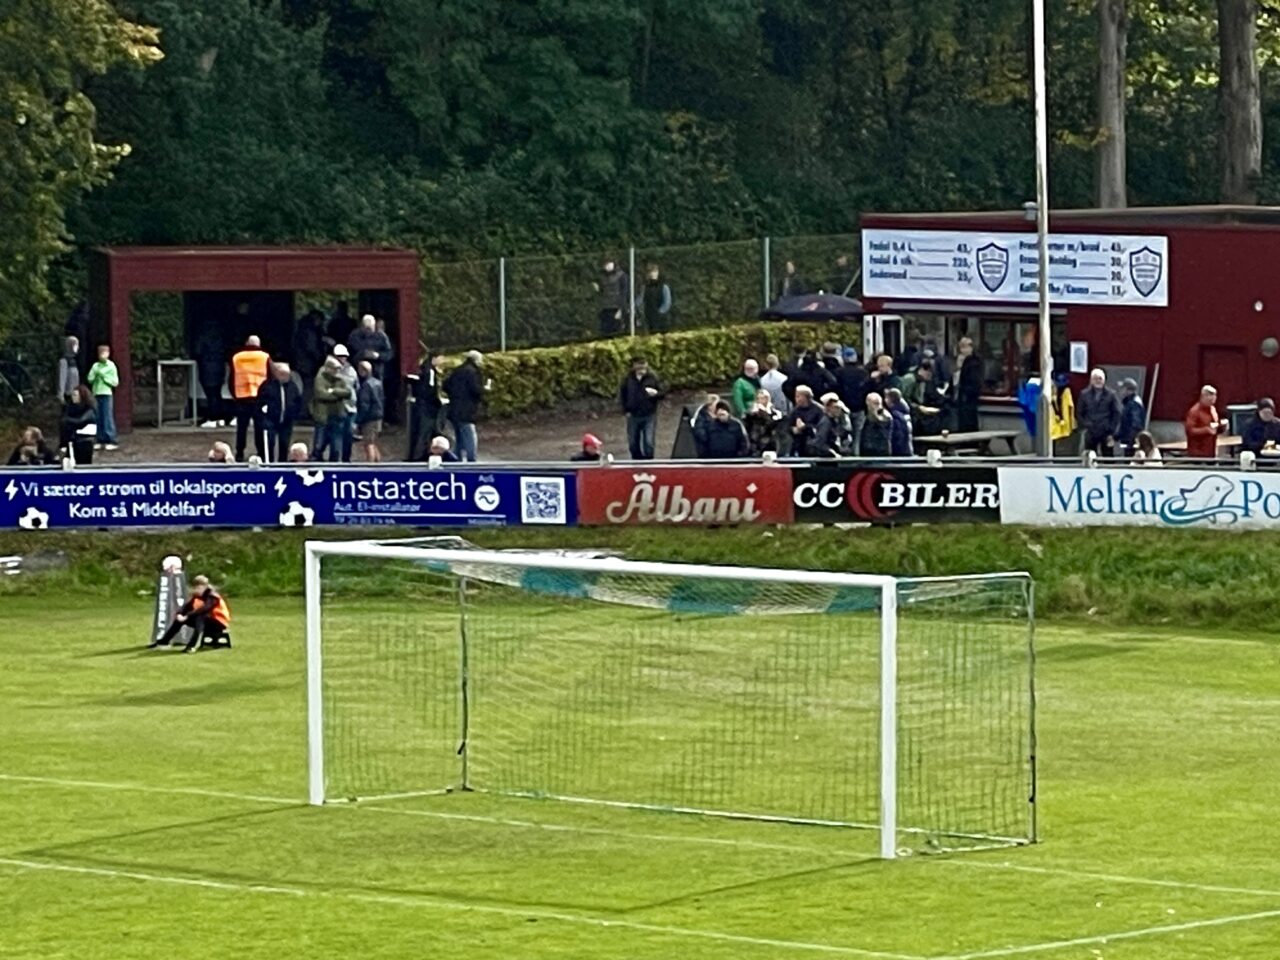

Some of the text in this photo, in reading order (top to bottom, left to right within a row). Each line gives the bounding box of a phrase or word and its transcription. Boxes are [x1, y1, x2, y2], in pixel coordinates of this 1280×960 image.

[21, 479, 265, 498] Vi sætter strøm til lokalsporten
[332, 473, 466, 500] insta:tech
[793, 482, 1000, 509] CC BILER
[1045, 473, 1164, 515] Melfar
[69, 501, 216, 518] Kom så Middelfart!
[606, 482, 761, 523] Albani
